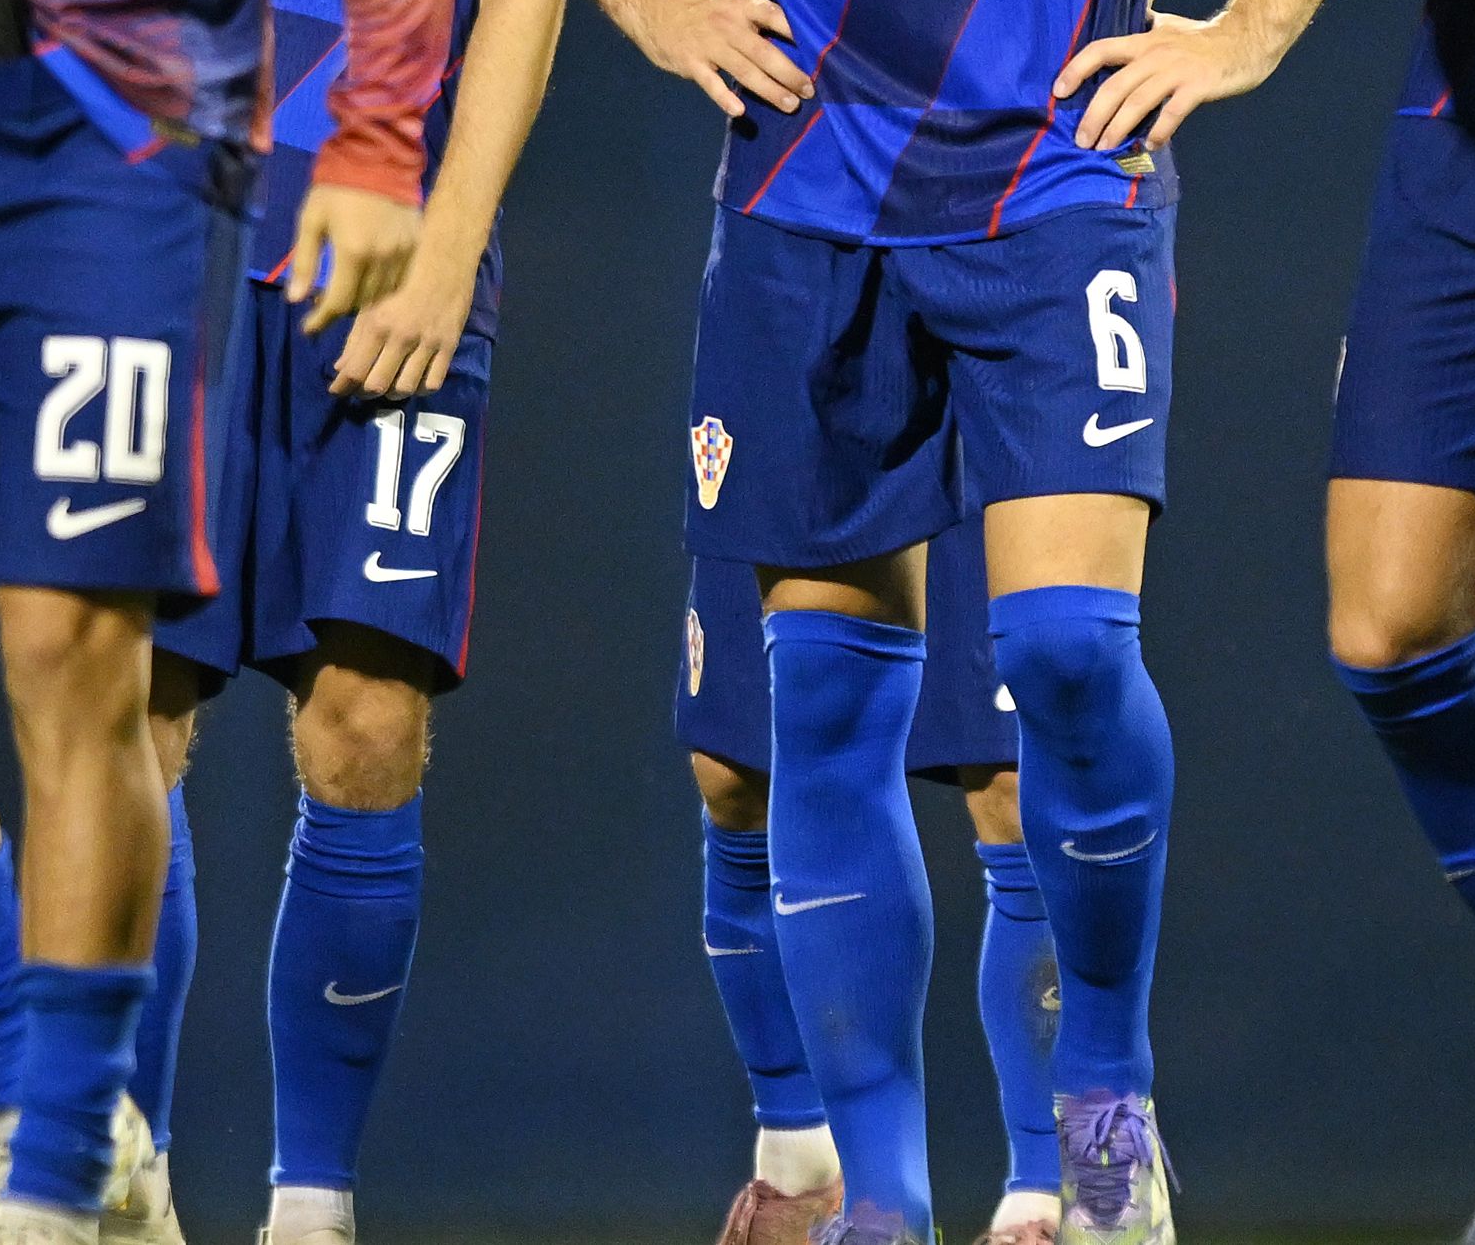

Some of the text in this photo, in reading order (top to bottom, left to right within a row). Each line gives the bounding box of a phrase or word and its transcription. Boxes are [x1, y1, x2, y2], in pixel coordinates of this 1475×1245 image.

[1086, 270, 1147, 394] 6
[33, 335, 172, 487] 20
[366, 409, 466, 537] 17
